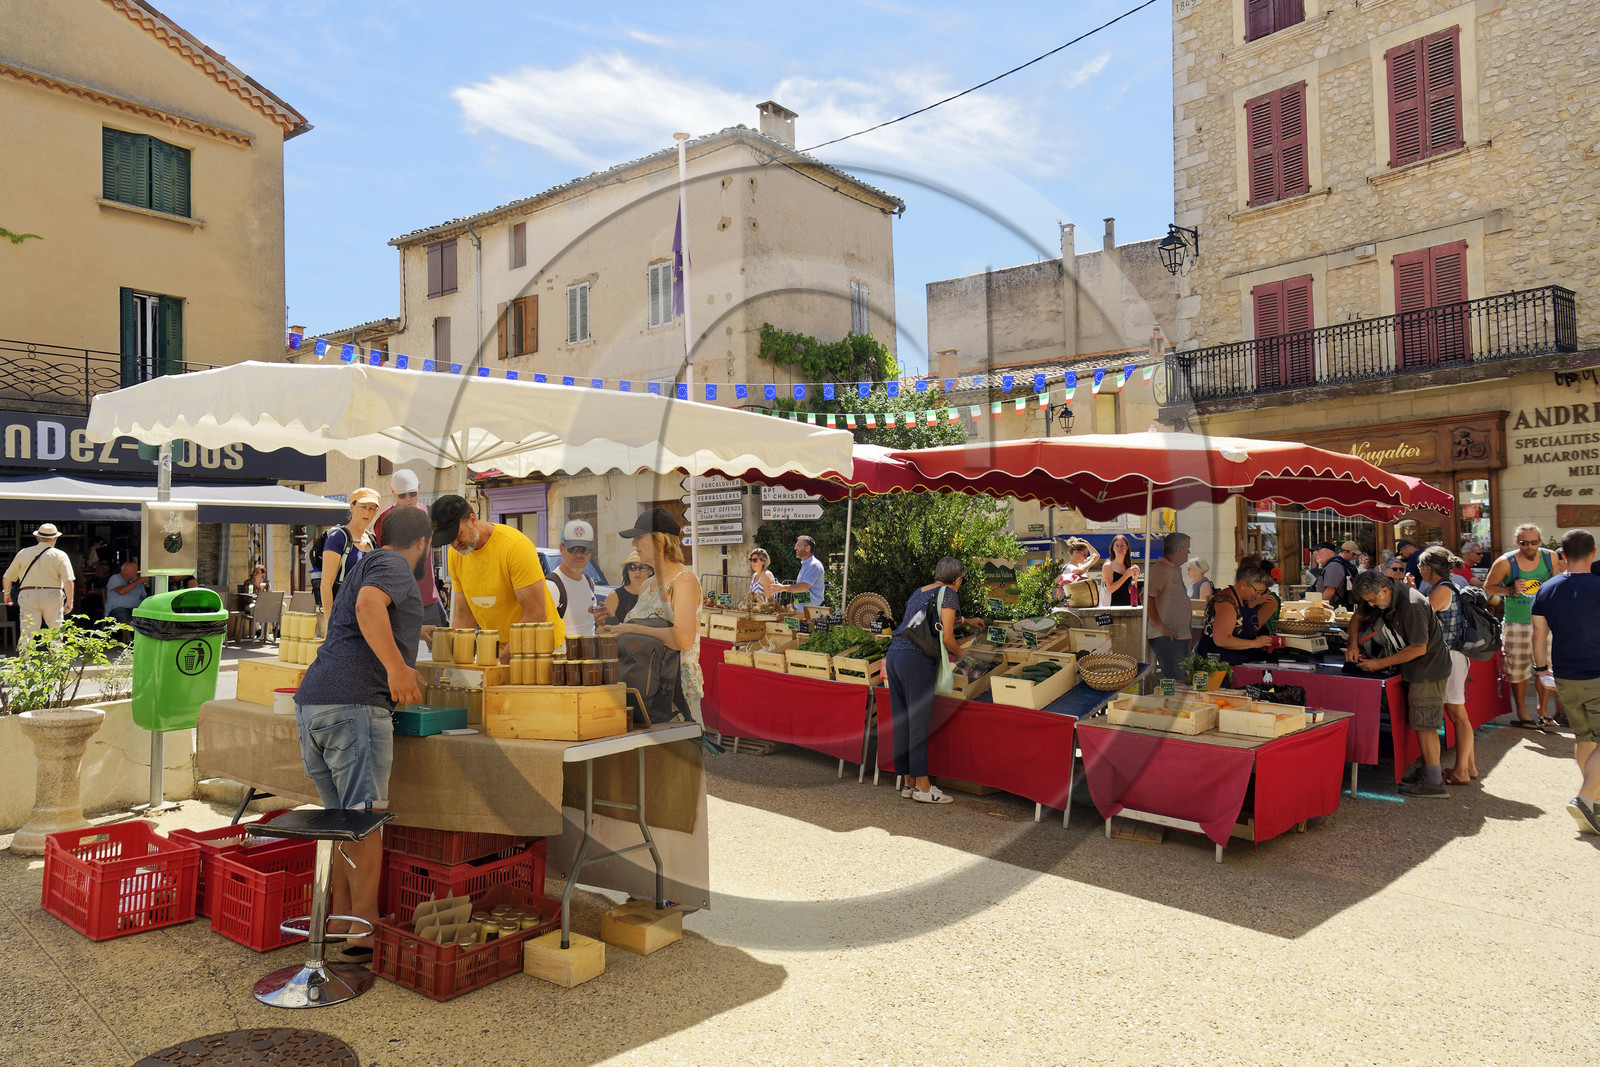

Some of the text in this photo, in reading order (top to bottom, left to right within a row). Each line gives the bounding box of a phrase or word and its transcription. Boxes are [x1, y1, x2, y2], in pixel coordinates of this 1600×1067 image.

[1515, 433, 1600, 449] SPECIALITES
[1349, 441, 1421, 466] Nougatier
[1523, 448, 1599, 464] MACARONS
[697, 493, 740, 501] FERRASSIÈRES
